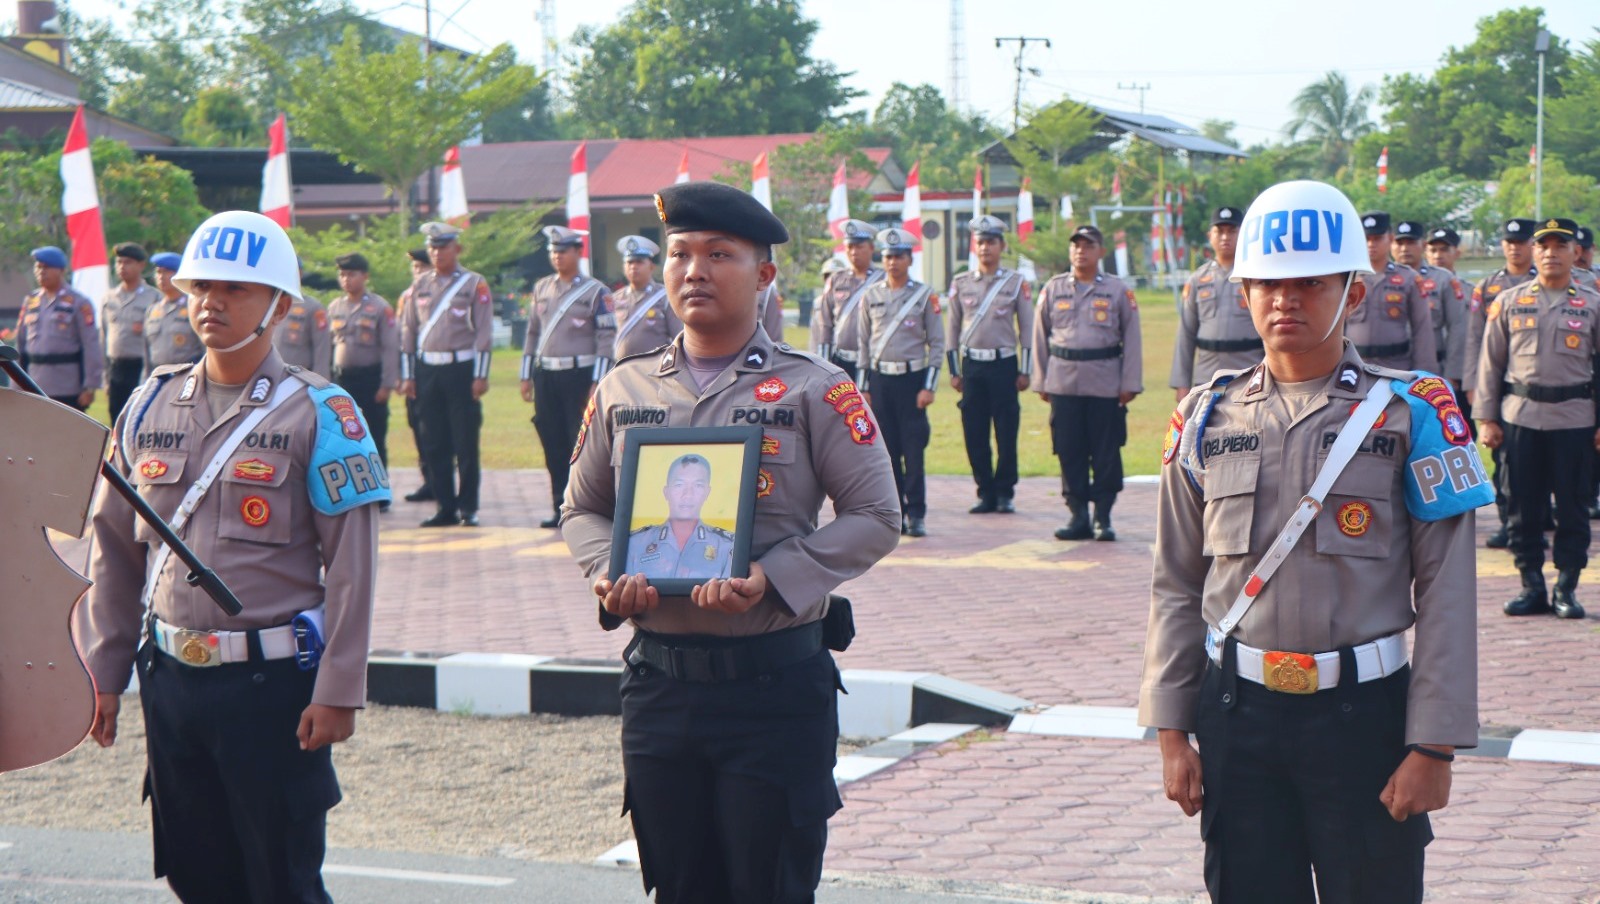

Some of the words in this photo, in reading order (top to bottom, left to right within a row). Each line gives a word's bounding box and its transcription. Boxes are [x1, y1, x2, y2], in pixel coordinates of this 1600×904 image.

[1242, 209, 1343, 262] PROV
[732, 408, 794, 427] POLRI
[138, 432, 184, 449] RENDY
[245, 432, 289, 450] OLRI
[1204, 433, 1259, 458] DELPIERO
[1322, 432, 1396, 456] PLRI
